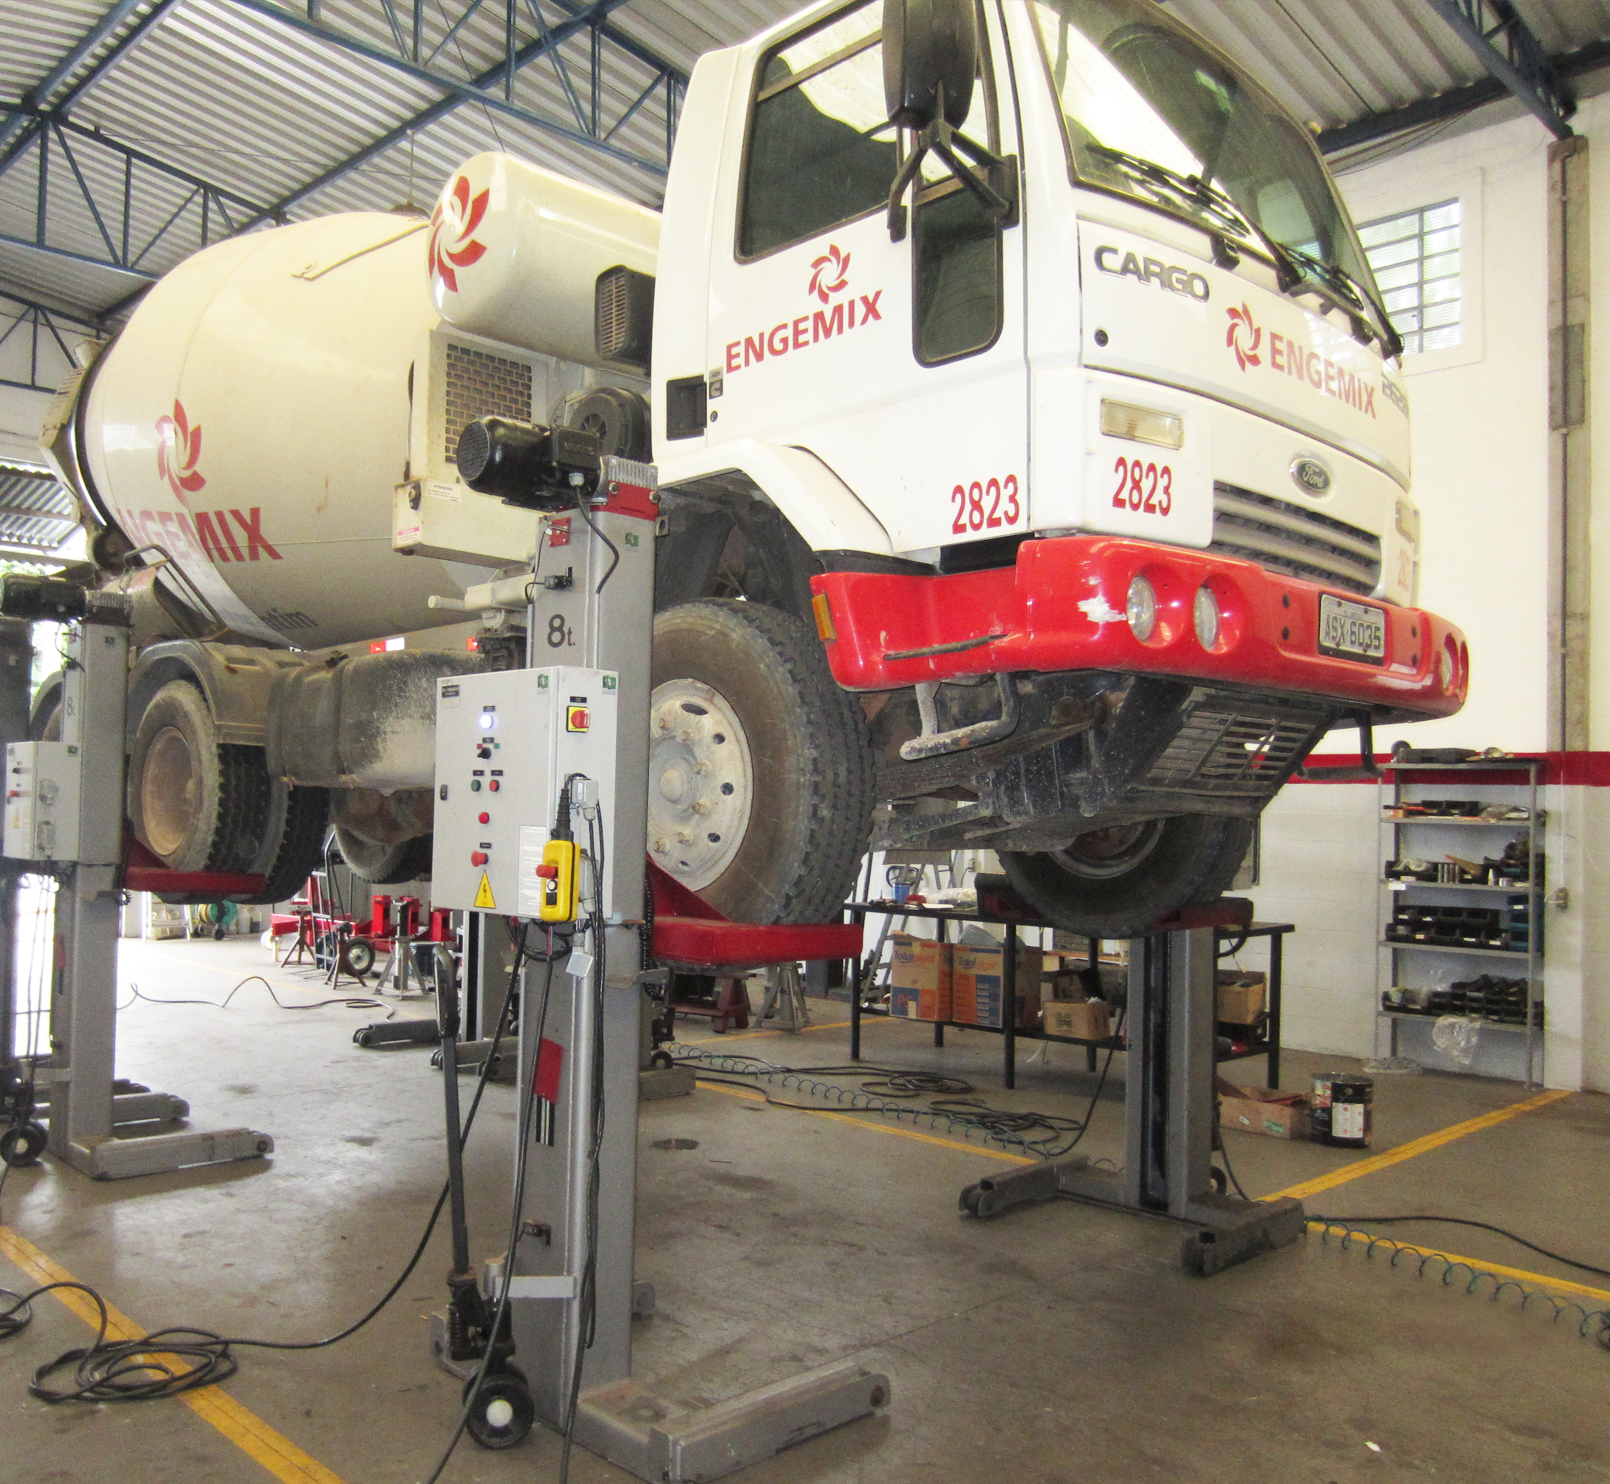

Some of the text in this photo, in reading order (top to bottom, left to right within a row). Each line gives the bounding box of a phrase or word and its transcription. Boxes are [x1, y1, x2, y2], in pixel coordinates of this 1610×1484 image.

[1093, 245, 1210, 303] CARGO
[726, 289, 883, 374] ENGEMIX
[1269, 331, 1377, 419] ENGEMIX
[951, 474, 1020, 535] 2823
[1111, 456, 1172, 517] 2823
[1302, 463, 1325, 488] Ford
